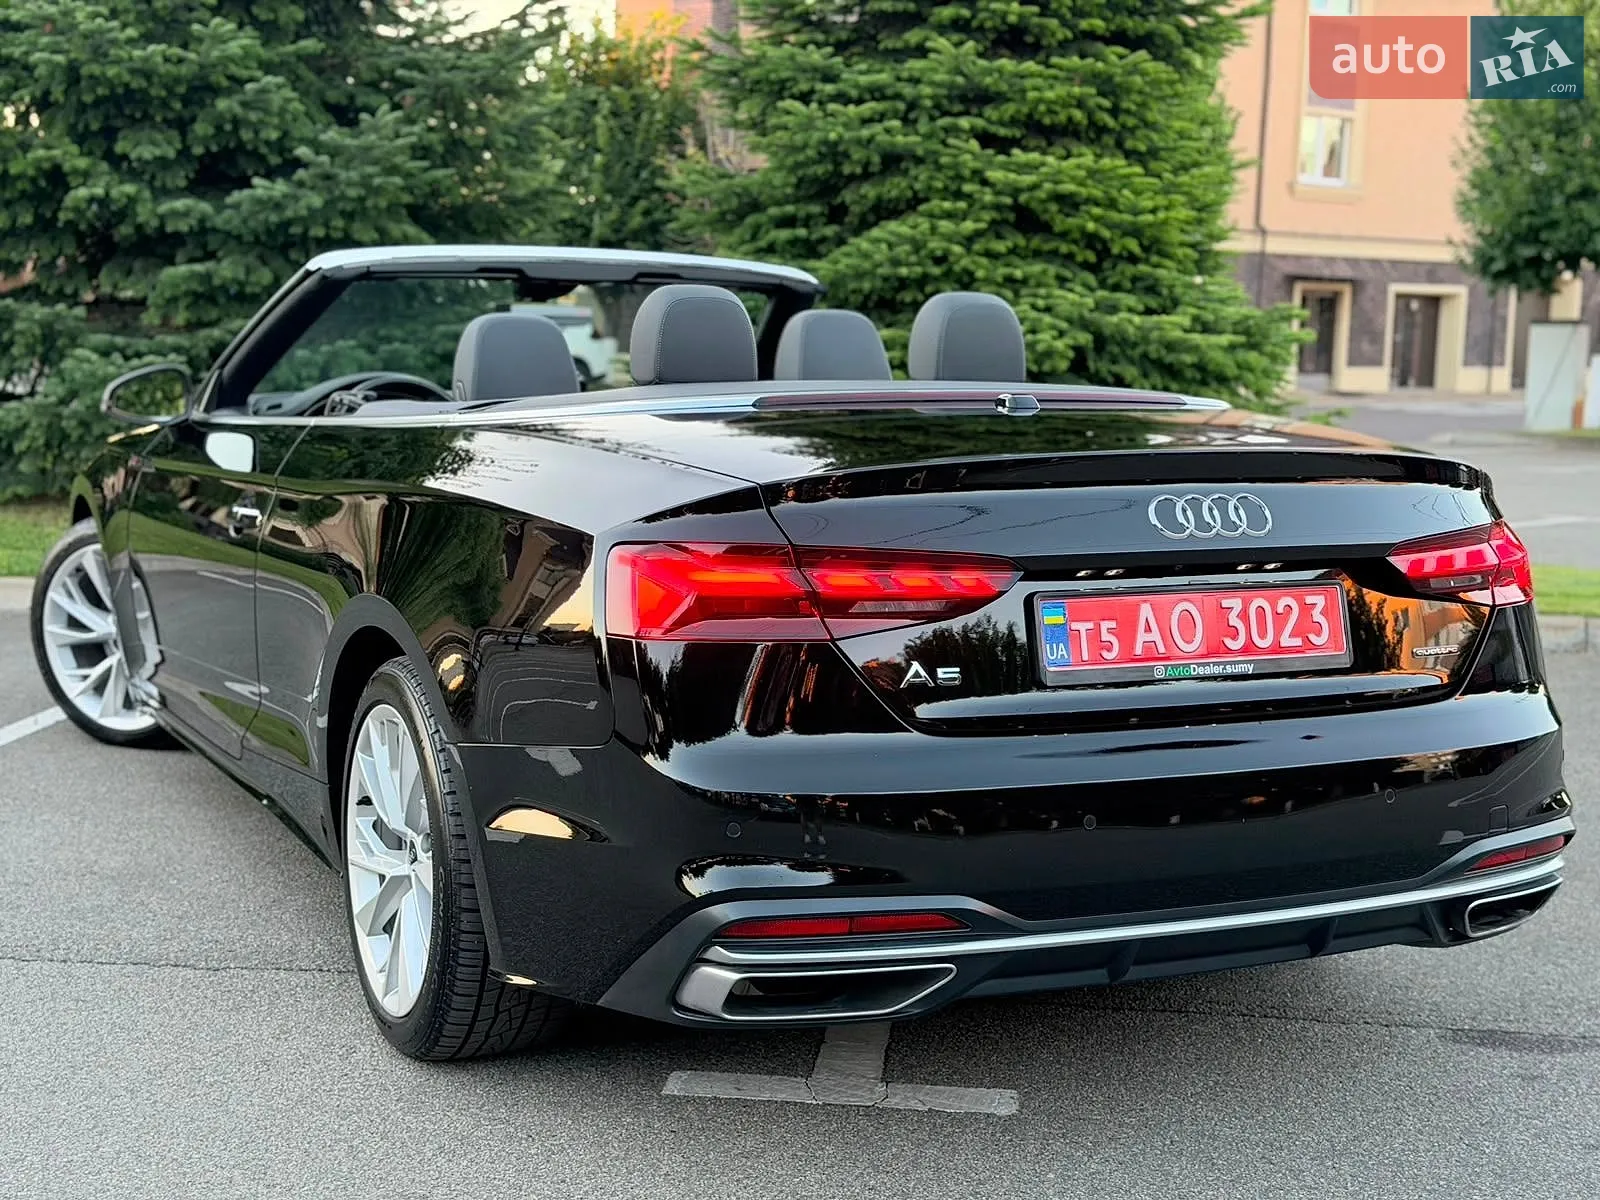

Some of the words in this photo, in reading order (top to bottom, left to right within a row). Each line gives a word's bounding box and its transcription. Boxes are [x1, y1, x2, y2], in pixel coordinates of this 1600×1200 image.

[1071, 618, 1120, 661] T5
[1134, 601, 1204, 656] AO
[1220, 595, 1331, 651] 3023
[1047, 643, 1068, 660] UA
[900, 661, 961, 688] A5
